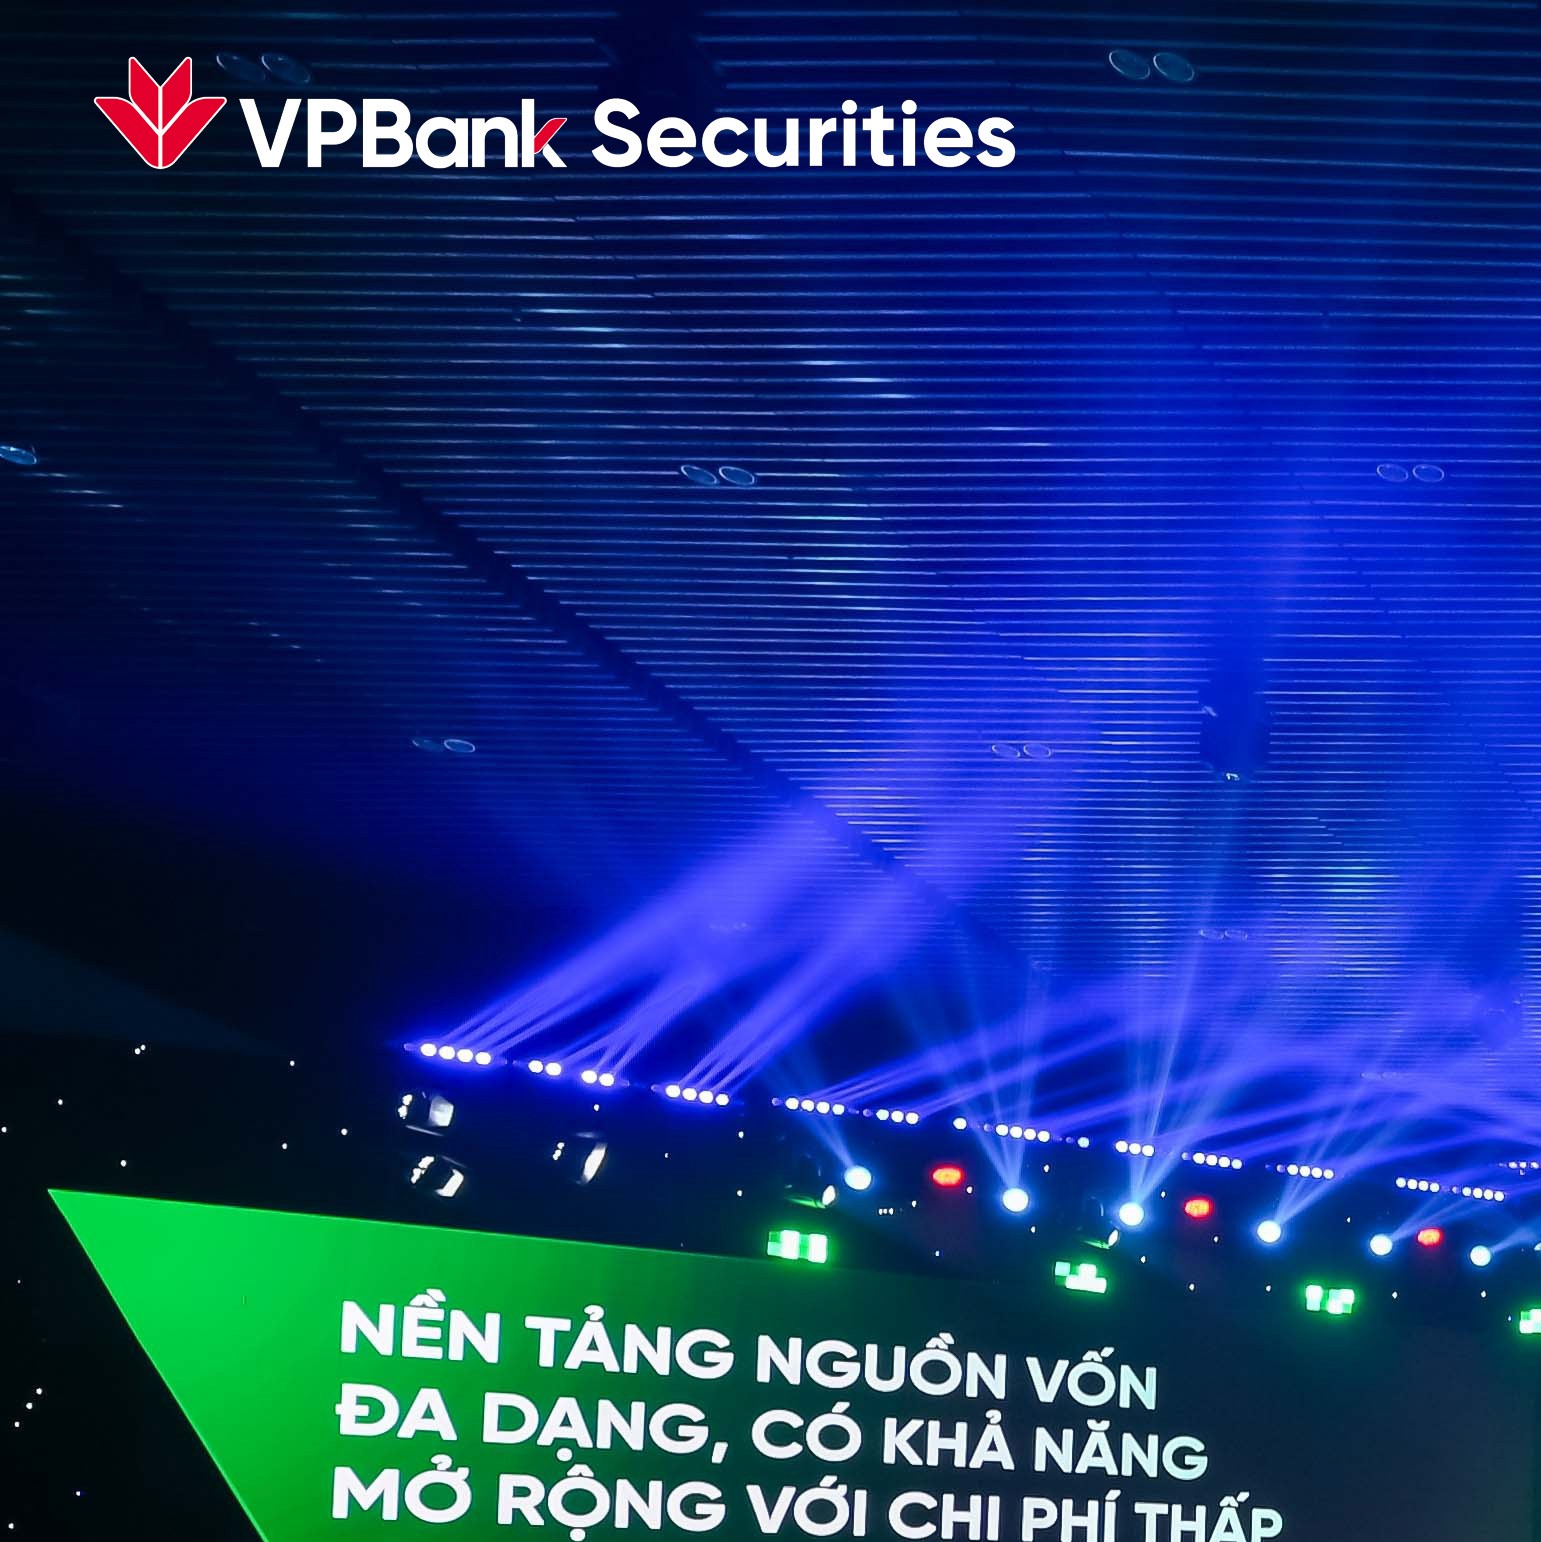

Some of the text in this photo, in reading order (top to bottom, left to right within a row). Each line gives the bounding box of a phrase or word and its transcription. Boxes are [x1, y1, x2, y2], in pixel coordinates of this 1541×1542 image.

[340, 1287, 1157, 1409] NỀN TẢNG NGUỒN VỐN
[336, 1382, 1207, 1480] ĐA DẠNG, CÓ KHẢ NĂNG
[331, 1455, 472, 1522] MỞ
[498, 1465, 725, 1542] RỘNG
[747, 1478, 868, 1539] VỚI
